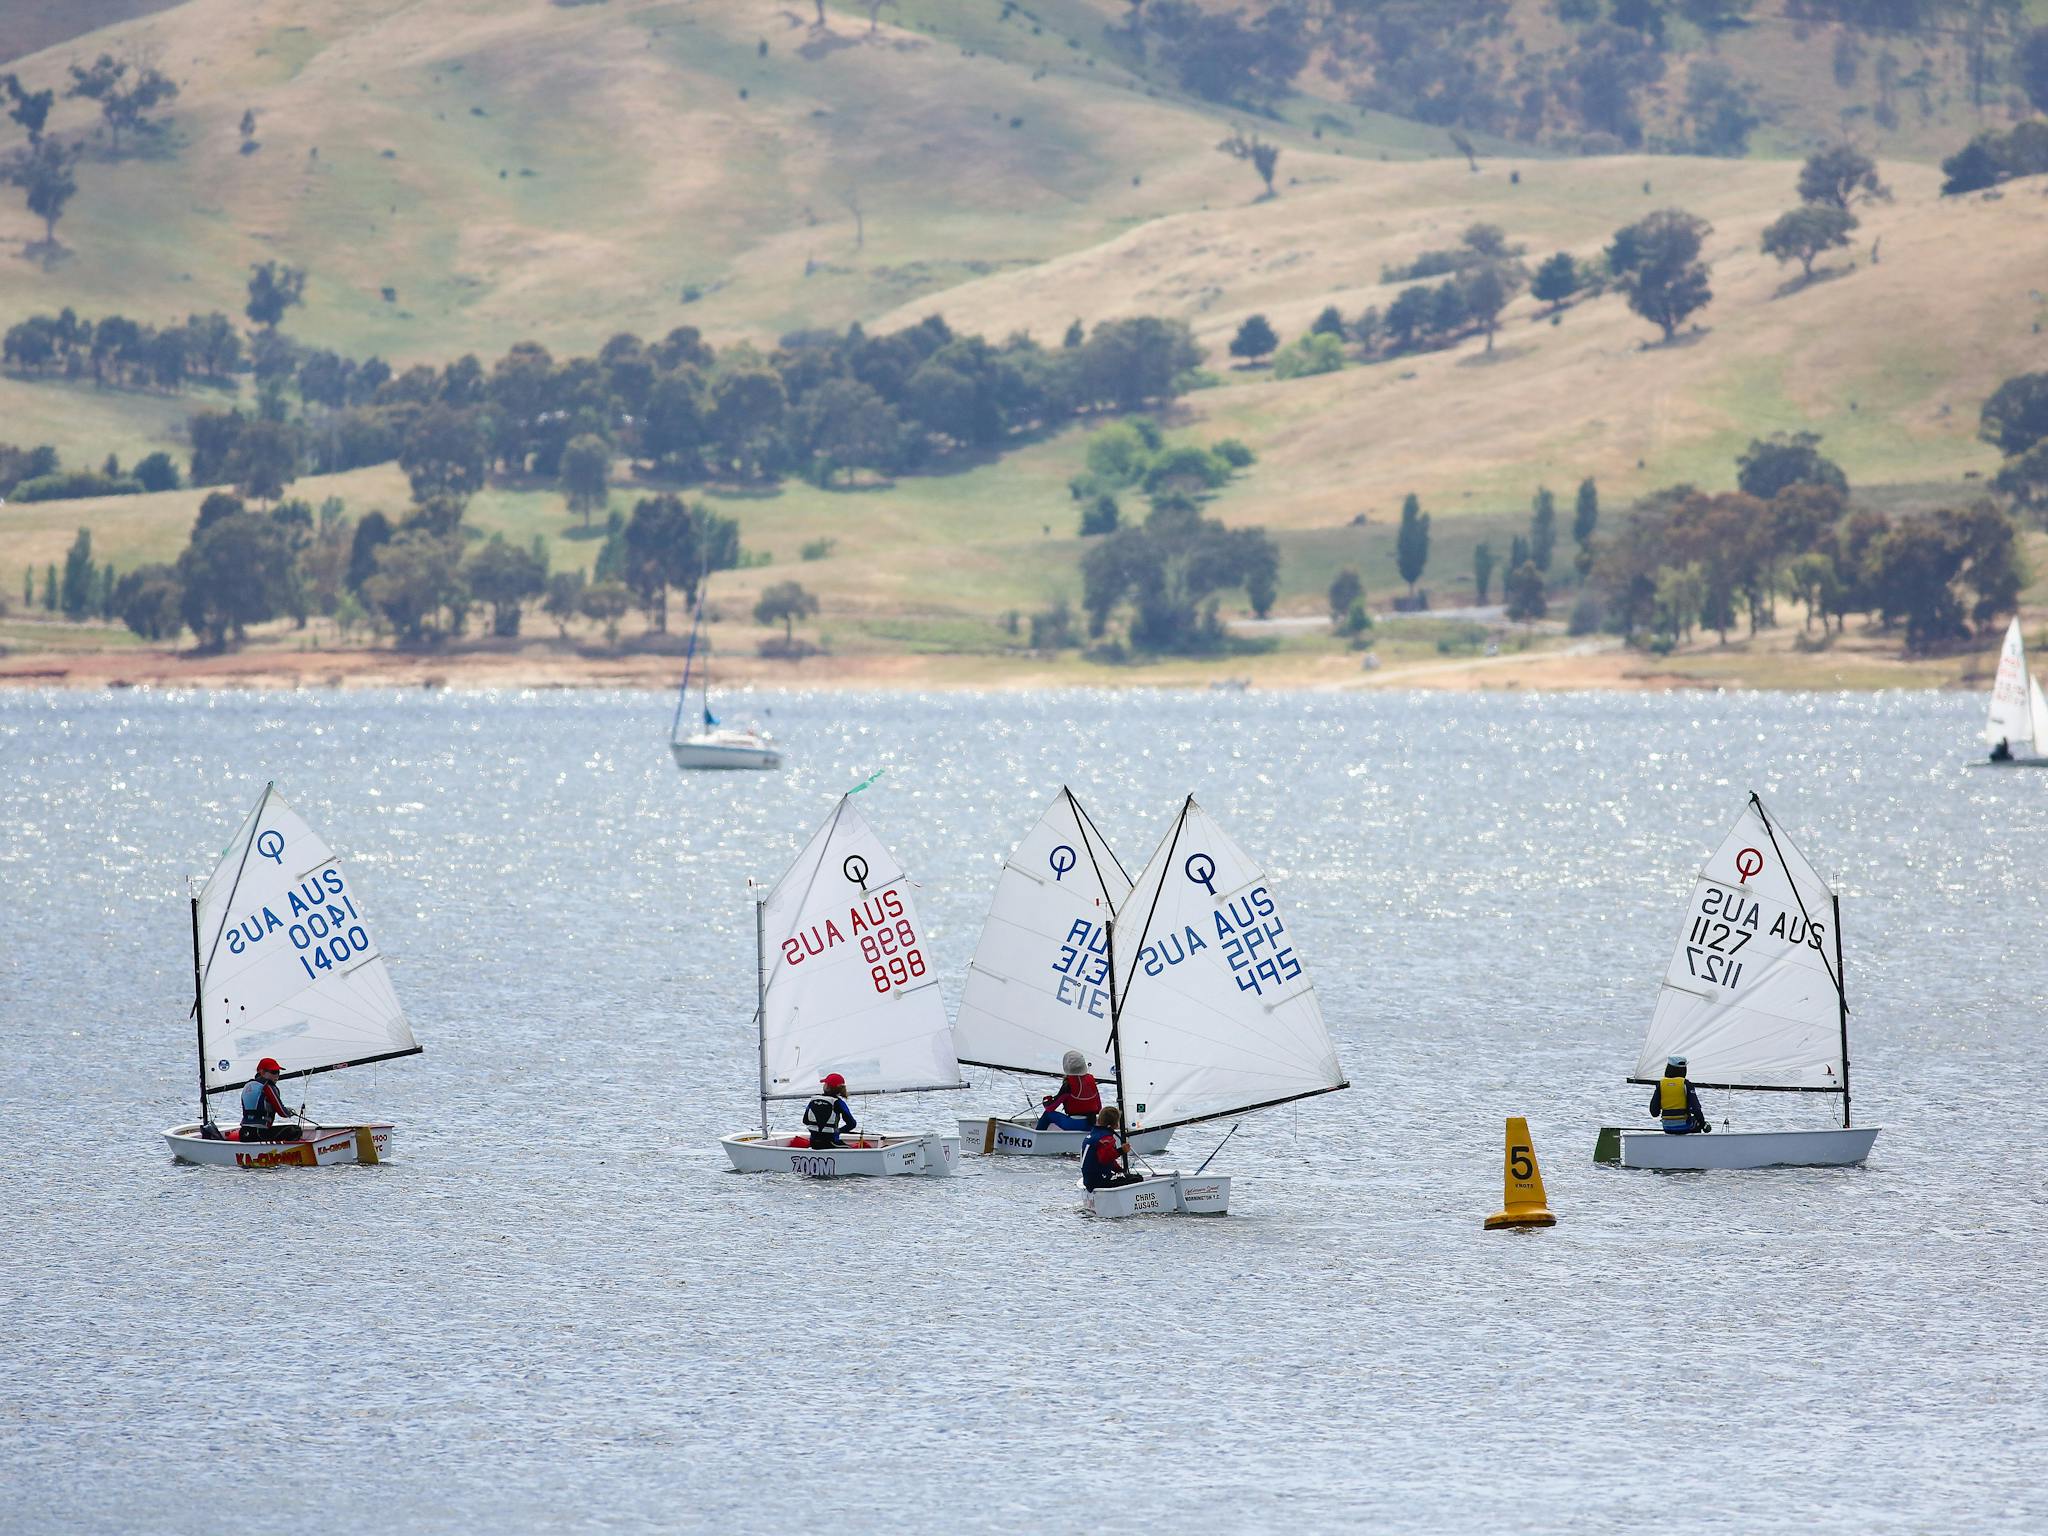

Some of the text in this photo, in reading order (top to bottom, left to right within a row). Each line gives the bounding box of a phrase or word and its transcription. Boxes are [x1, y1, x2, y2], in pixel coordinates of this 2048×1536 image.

[287, 869, 344, 918] AUS
[850, 889, 904, 936] AUS
[1213, 886, 1275, 940] AUS
[1066, 918, 1110, 955] AU
[1689, 916, 1753, 956] 1127
[1769, 911, 1825, 950] AUS
[300, 925, 369, 980] 1400
[871, 950, 926, 993] 898
[1052, 945, 1110, 987] 313
[1235, 946, 1302, 996] 495
[791, 1156, 836, 1176] ZOOM
[1511, 1146, 1534, 1181] 5
[1134, 1201, 1159, 1210] AUS495
[1135, 1192, 1156, 1202] CHRIS
